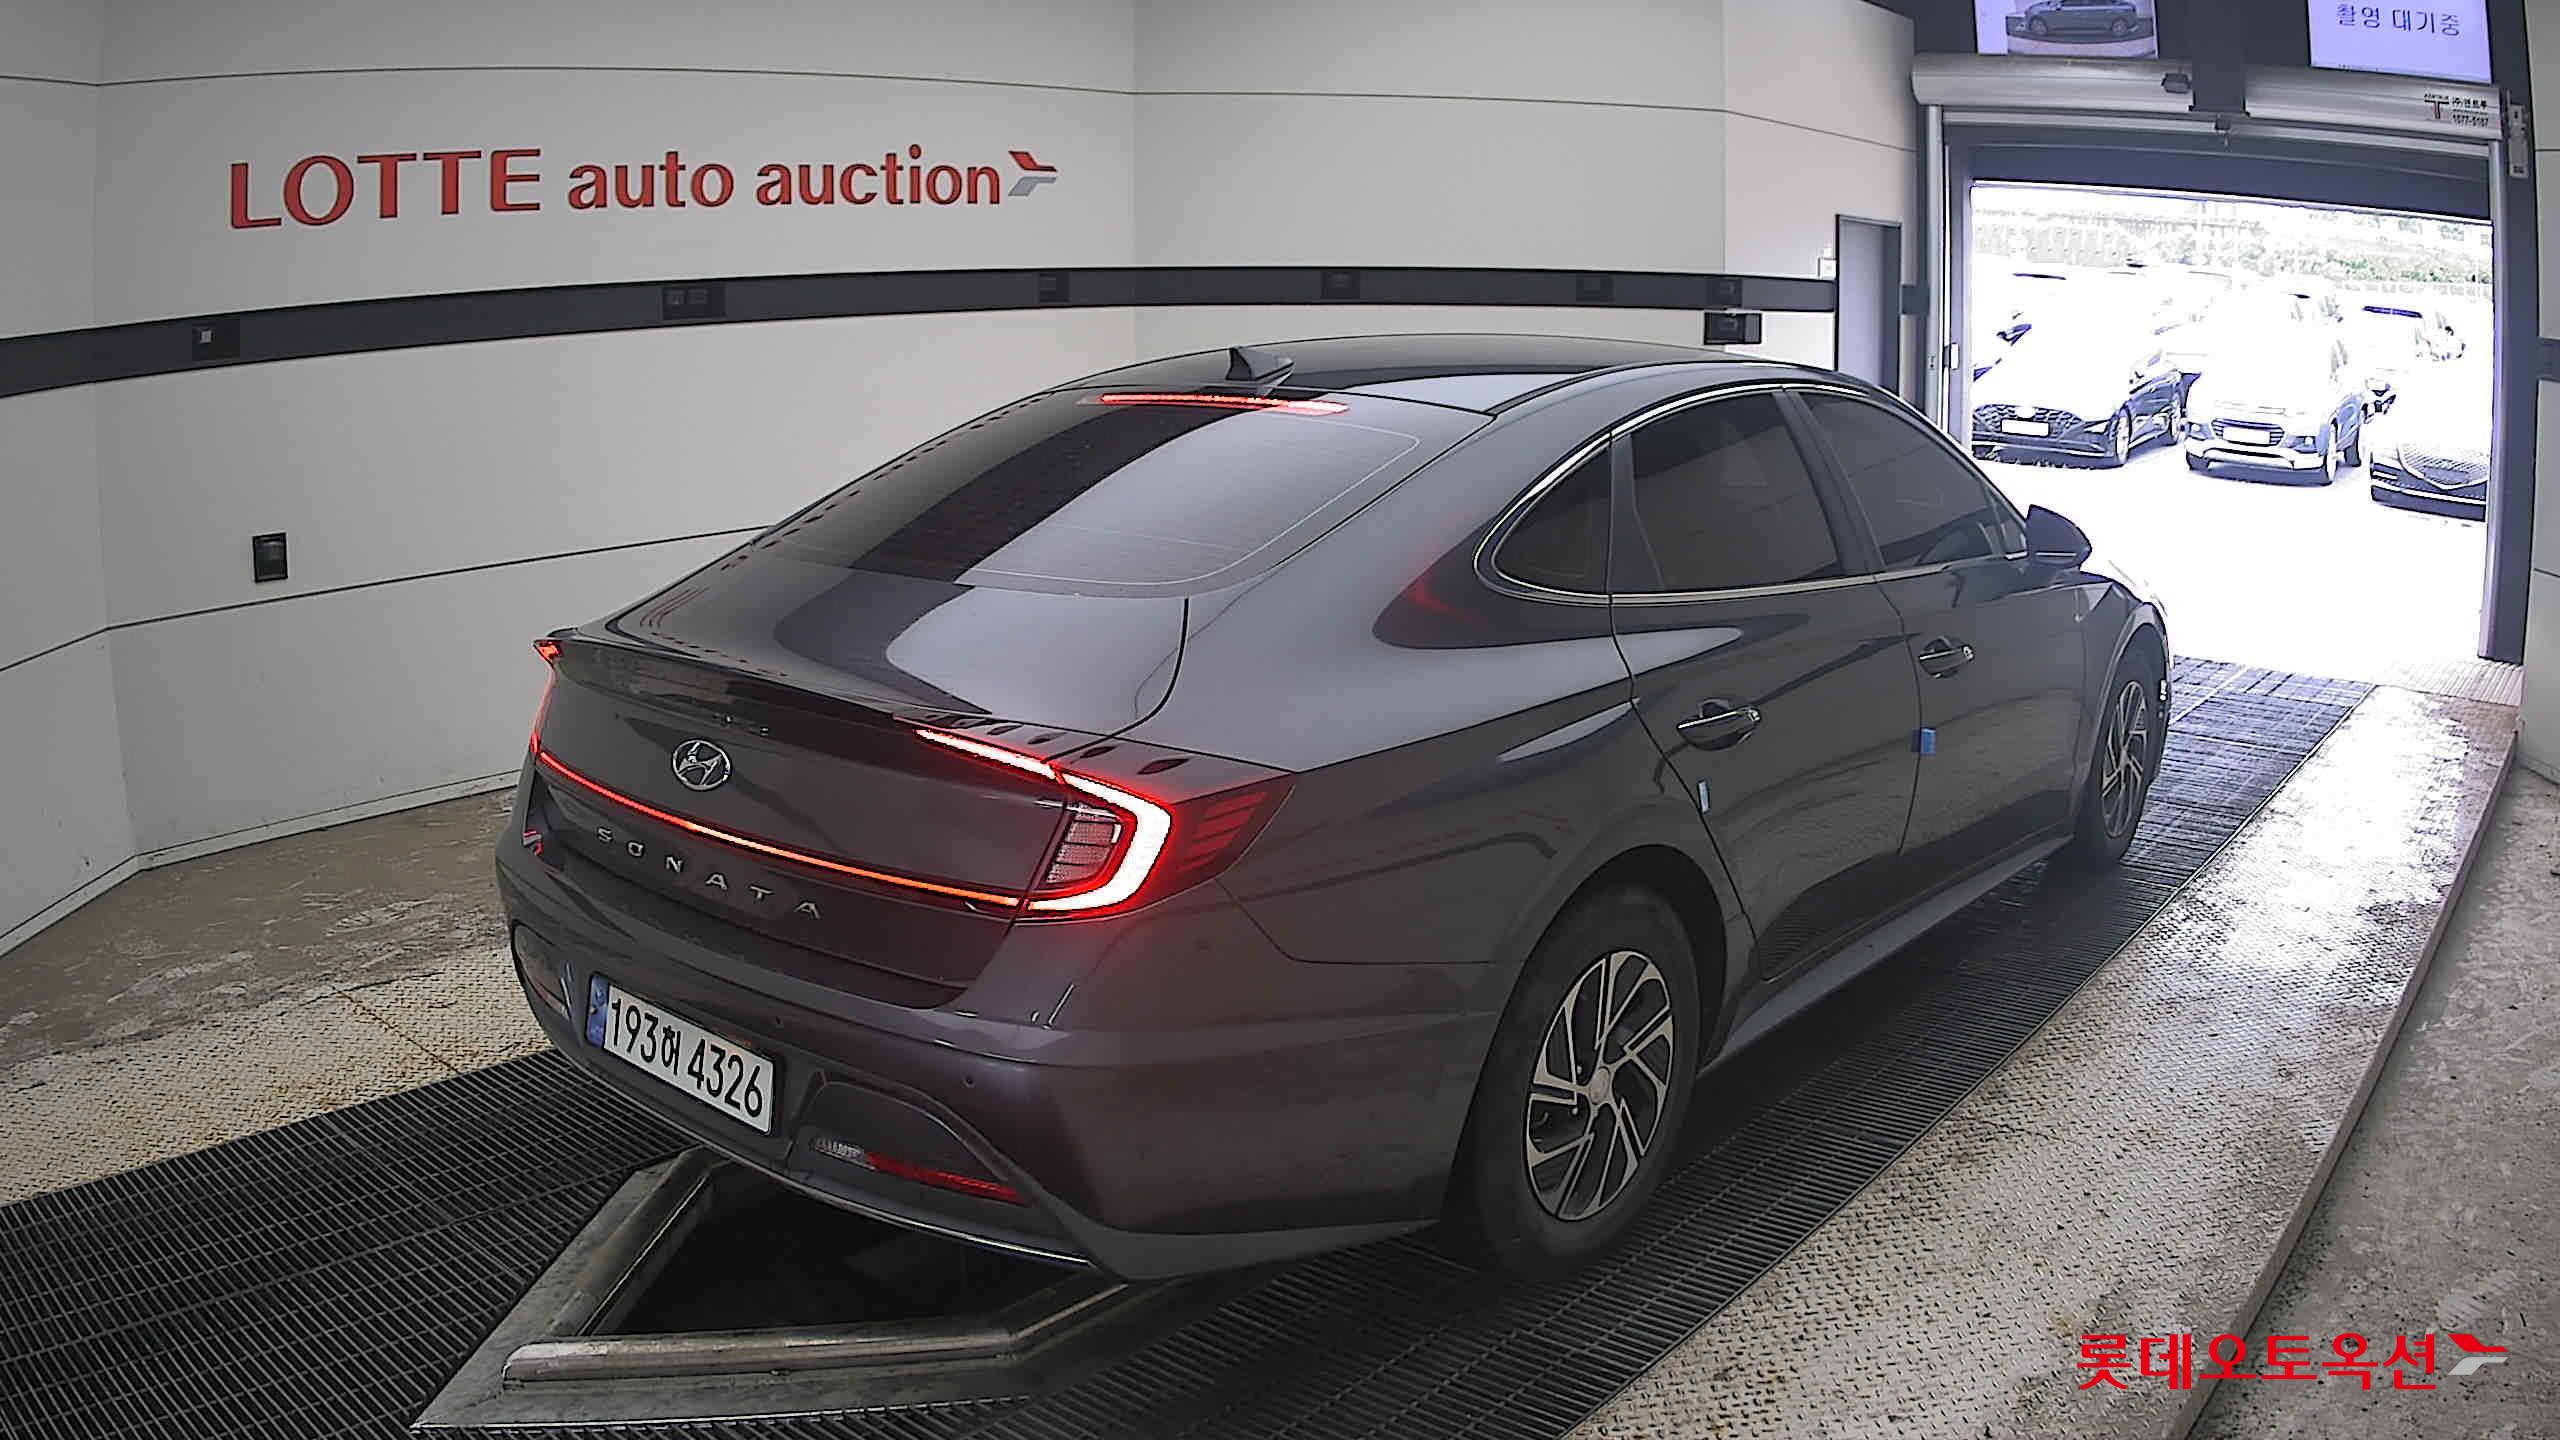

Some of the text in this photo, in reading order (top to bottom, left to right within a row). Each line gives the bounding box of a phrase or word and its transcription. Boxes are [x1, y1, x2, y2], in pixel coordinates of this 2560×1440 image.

[2337, 4, 2460, 36] 촬영 대기중
[231, 143, 1001, 229] LOTTE auto auction
[597, 826, 821, 919] SONATA
[611, 998, 763, 1118] 193허 4326
